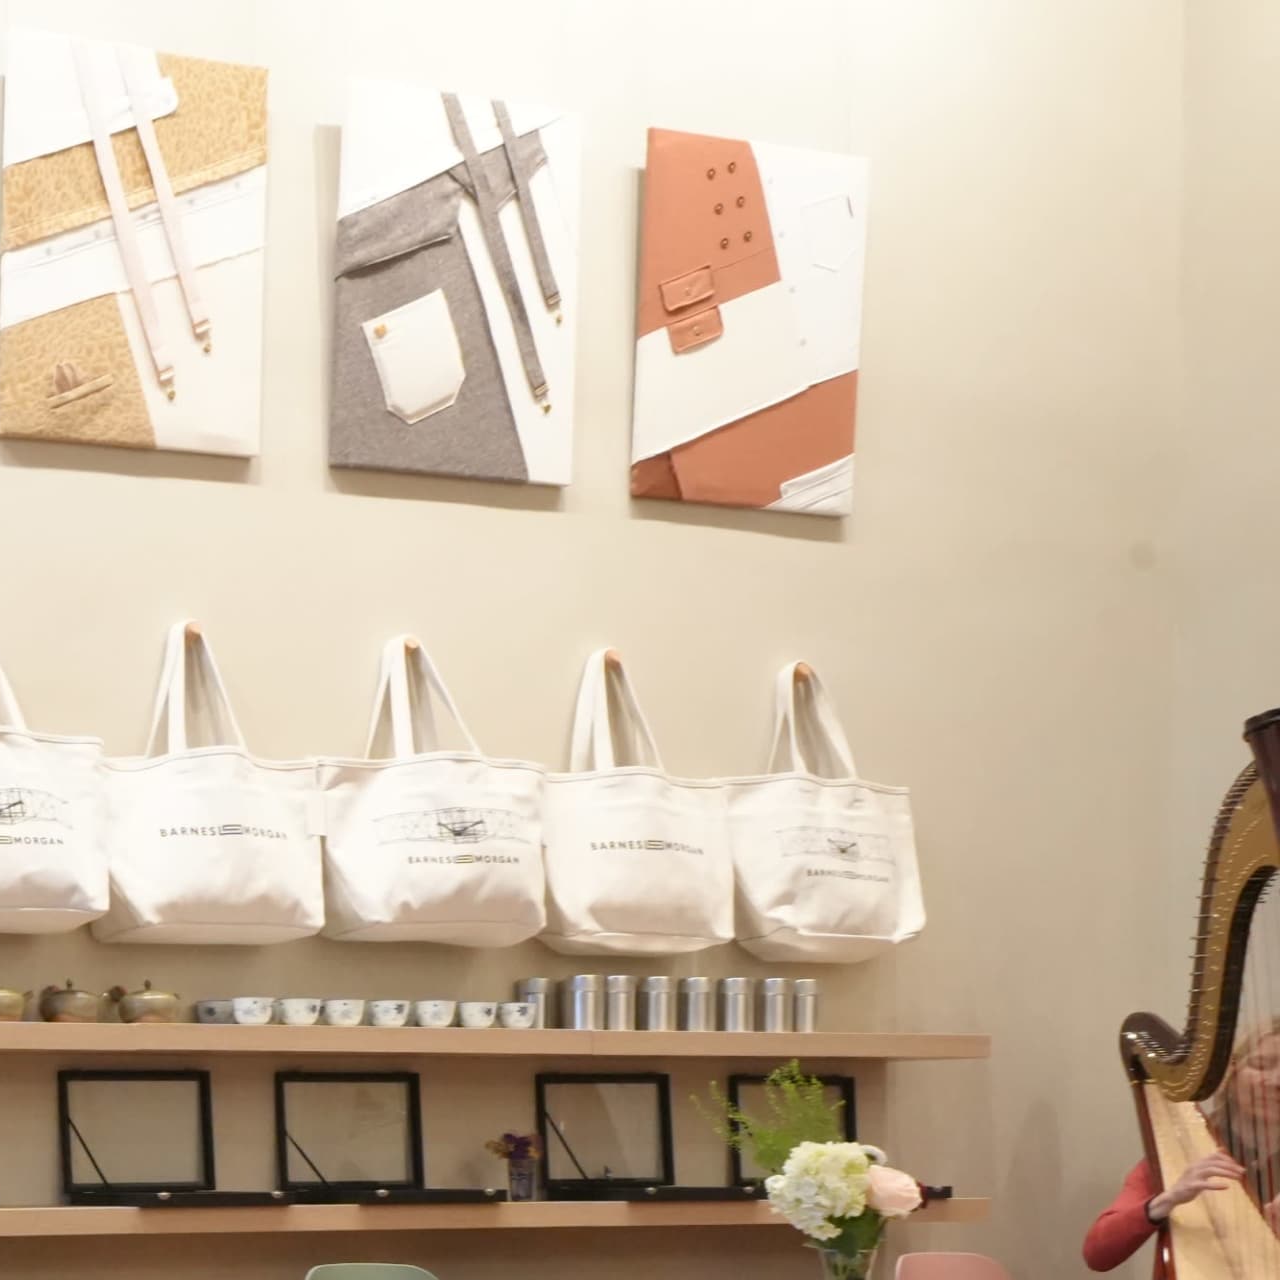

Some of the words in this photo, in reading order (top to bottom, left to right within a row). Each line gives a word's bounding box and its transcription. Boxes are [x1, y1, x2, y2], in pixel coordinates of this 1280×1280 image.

[160, 826, 217, 838] BARNES
[14, 836, 65, 845] MORGAN
[474, 855, 520, 864] MORGAN
